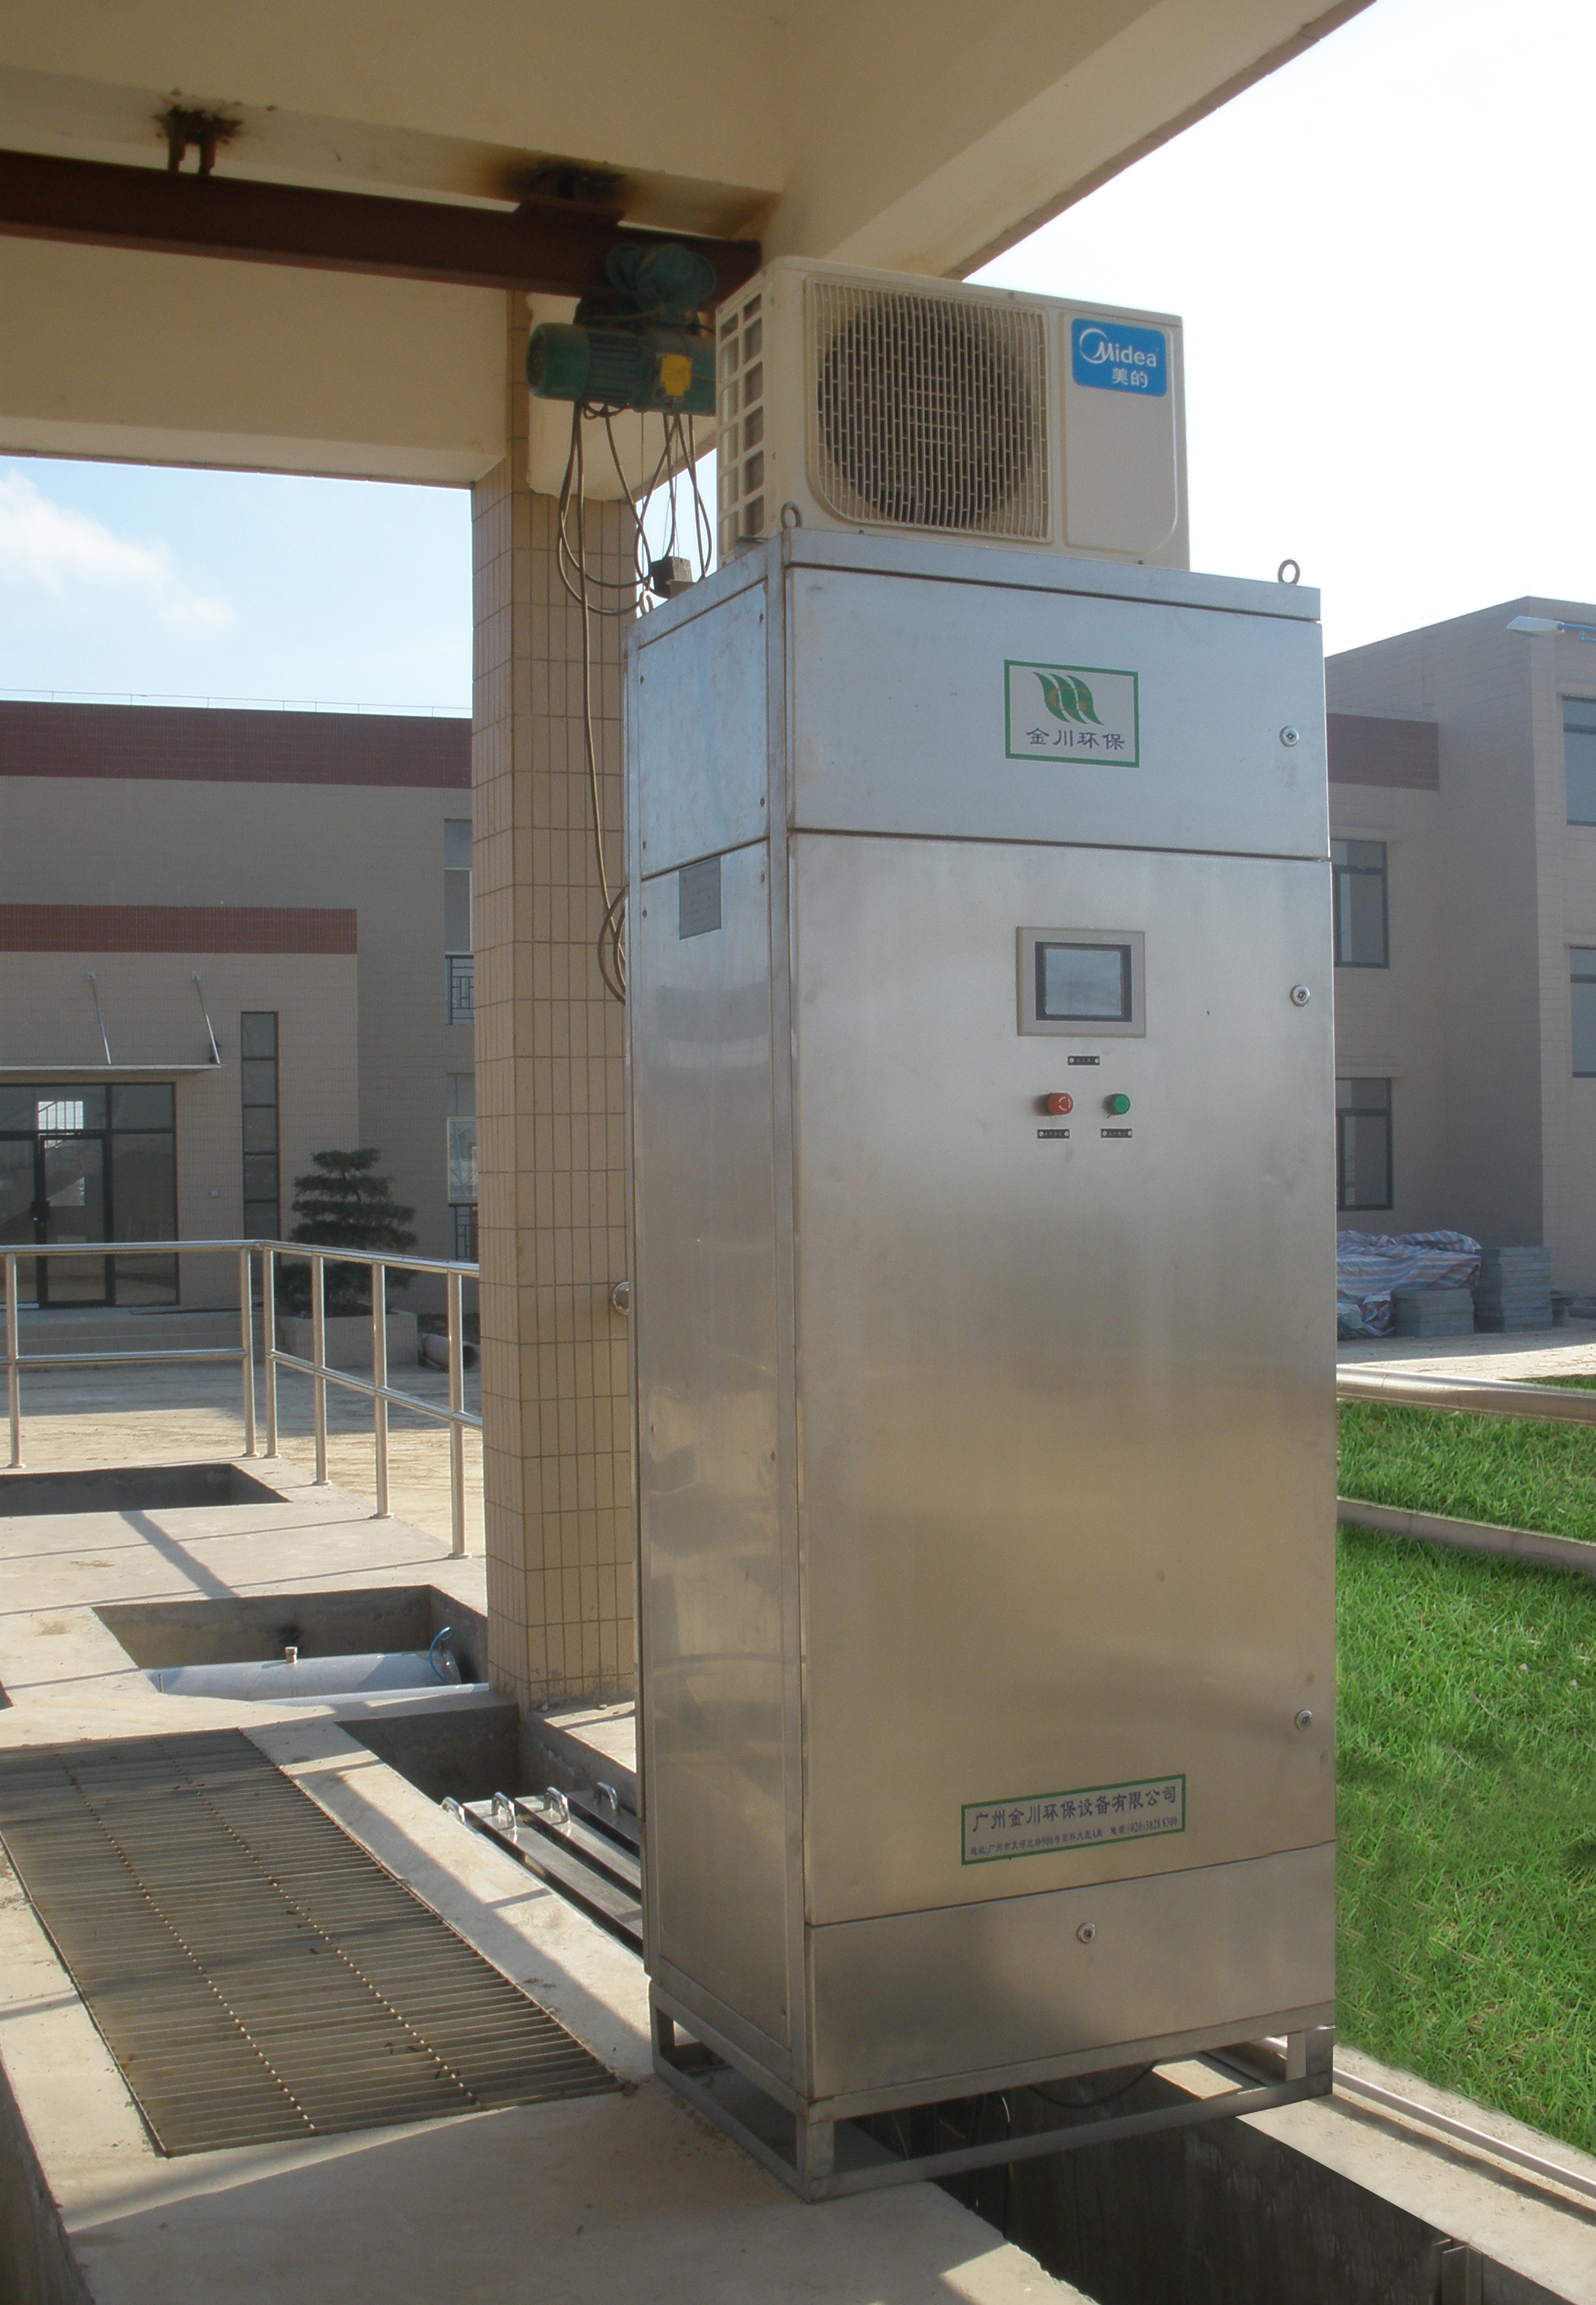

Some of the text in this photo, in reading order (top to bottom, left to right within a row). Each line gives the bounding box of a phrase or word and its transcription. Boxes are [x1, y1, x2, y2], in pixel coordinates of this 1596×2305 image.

[1090, 338, 1157, 367] Midea
[1111, 367, 1148, 389] 美的
[1026, 728, 1125, 750] 金川环保
[972, 1785, 1176, 1833] 广州金川环保设备有限公司
